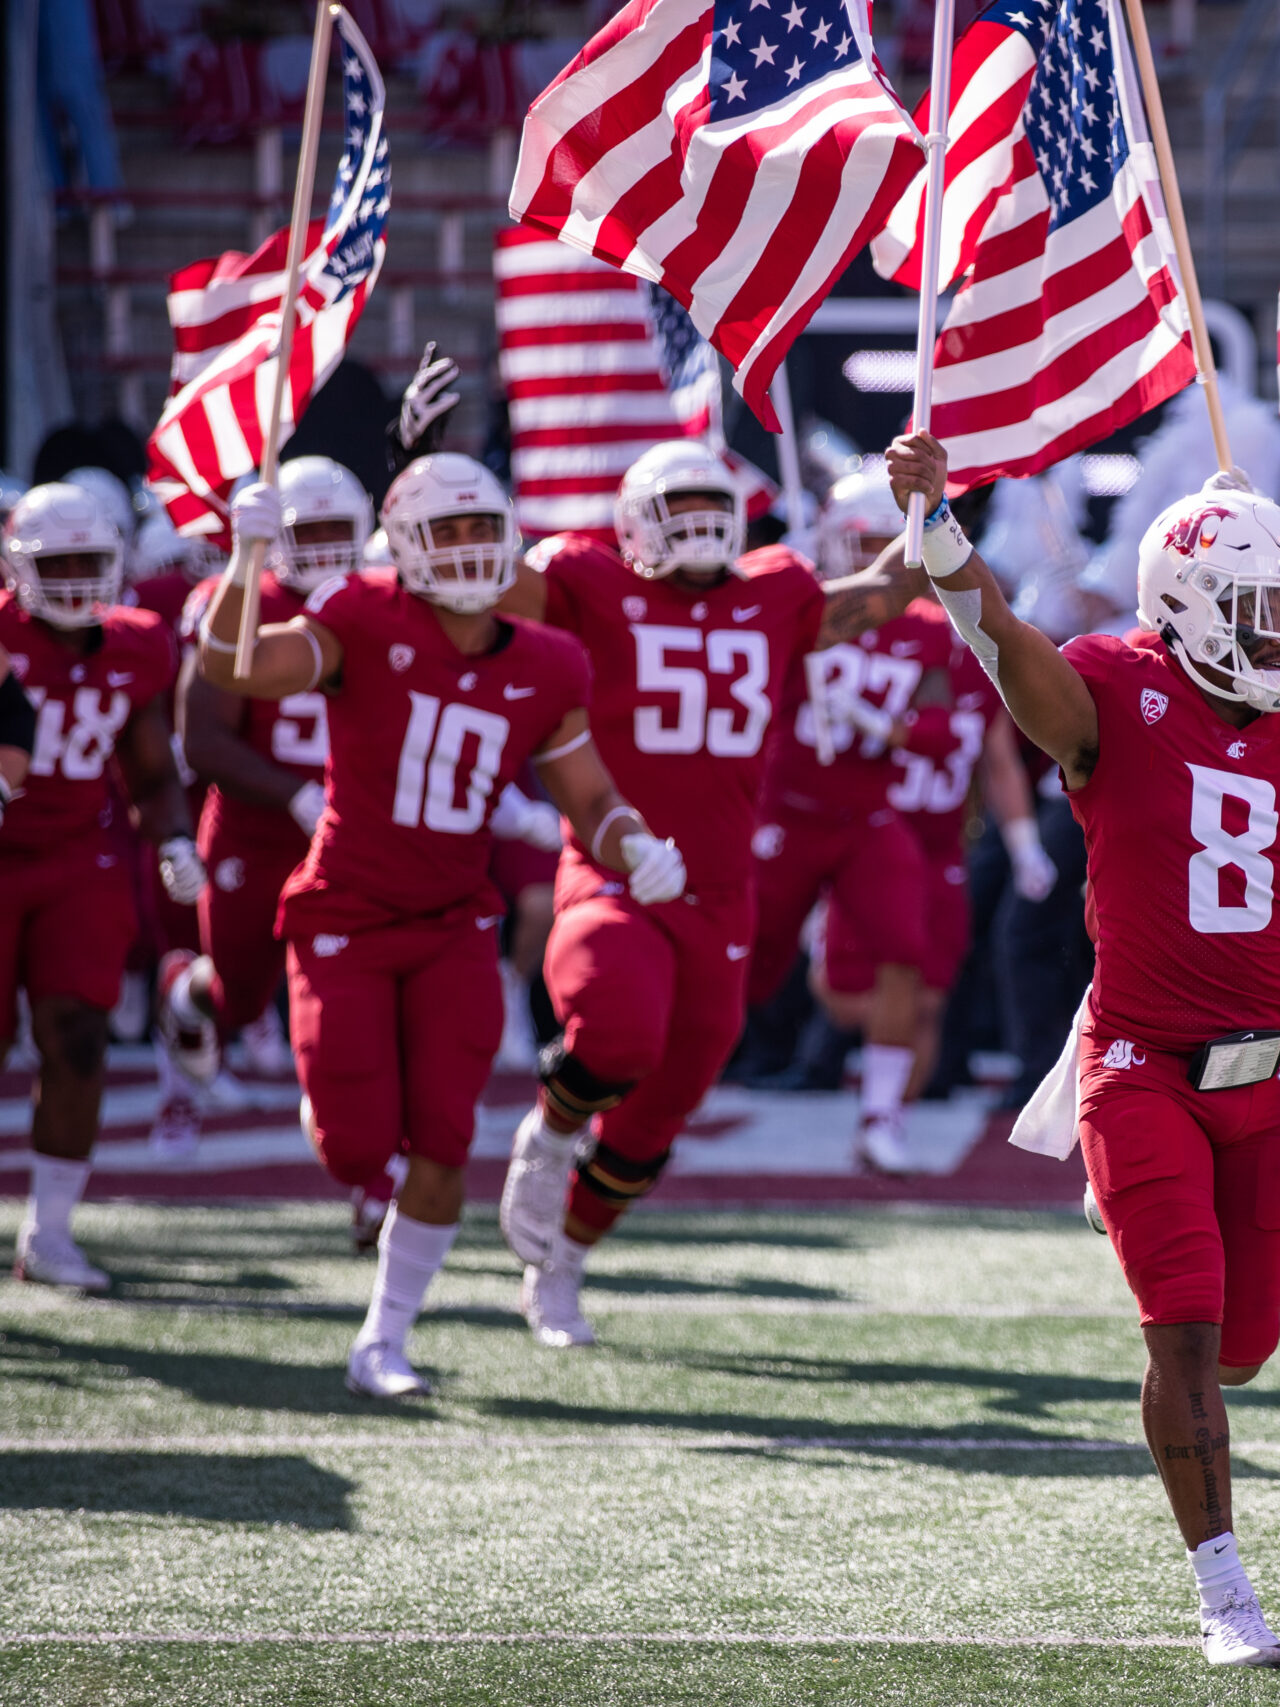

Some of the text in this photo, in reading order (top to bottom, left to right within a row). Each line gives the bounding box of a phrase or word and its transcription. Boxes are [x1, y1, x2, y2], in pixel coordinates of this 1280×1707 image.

[630, 623, 771, 758] 53
[1142, 690, 1167, 714] PAC
[1145, 703, 1160, 719] 12
[392, 690, 510, 834] 10
[1184, 762, 1279, 933] 8
